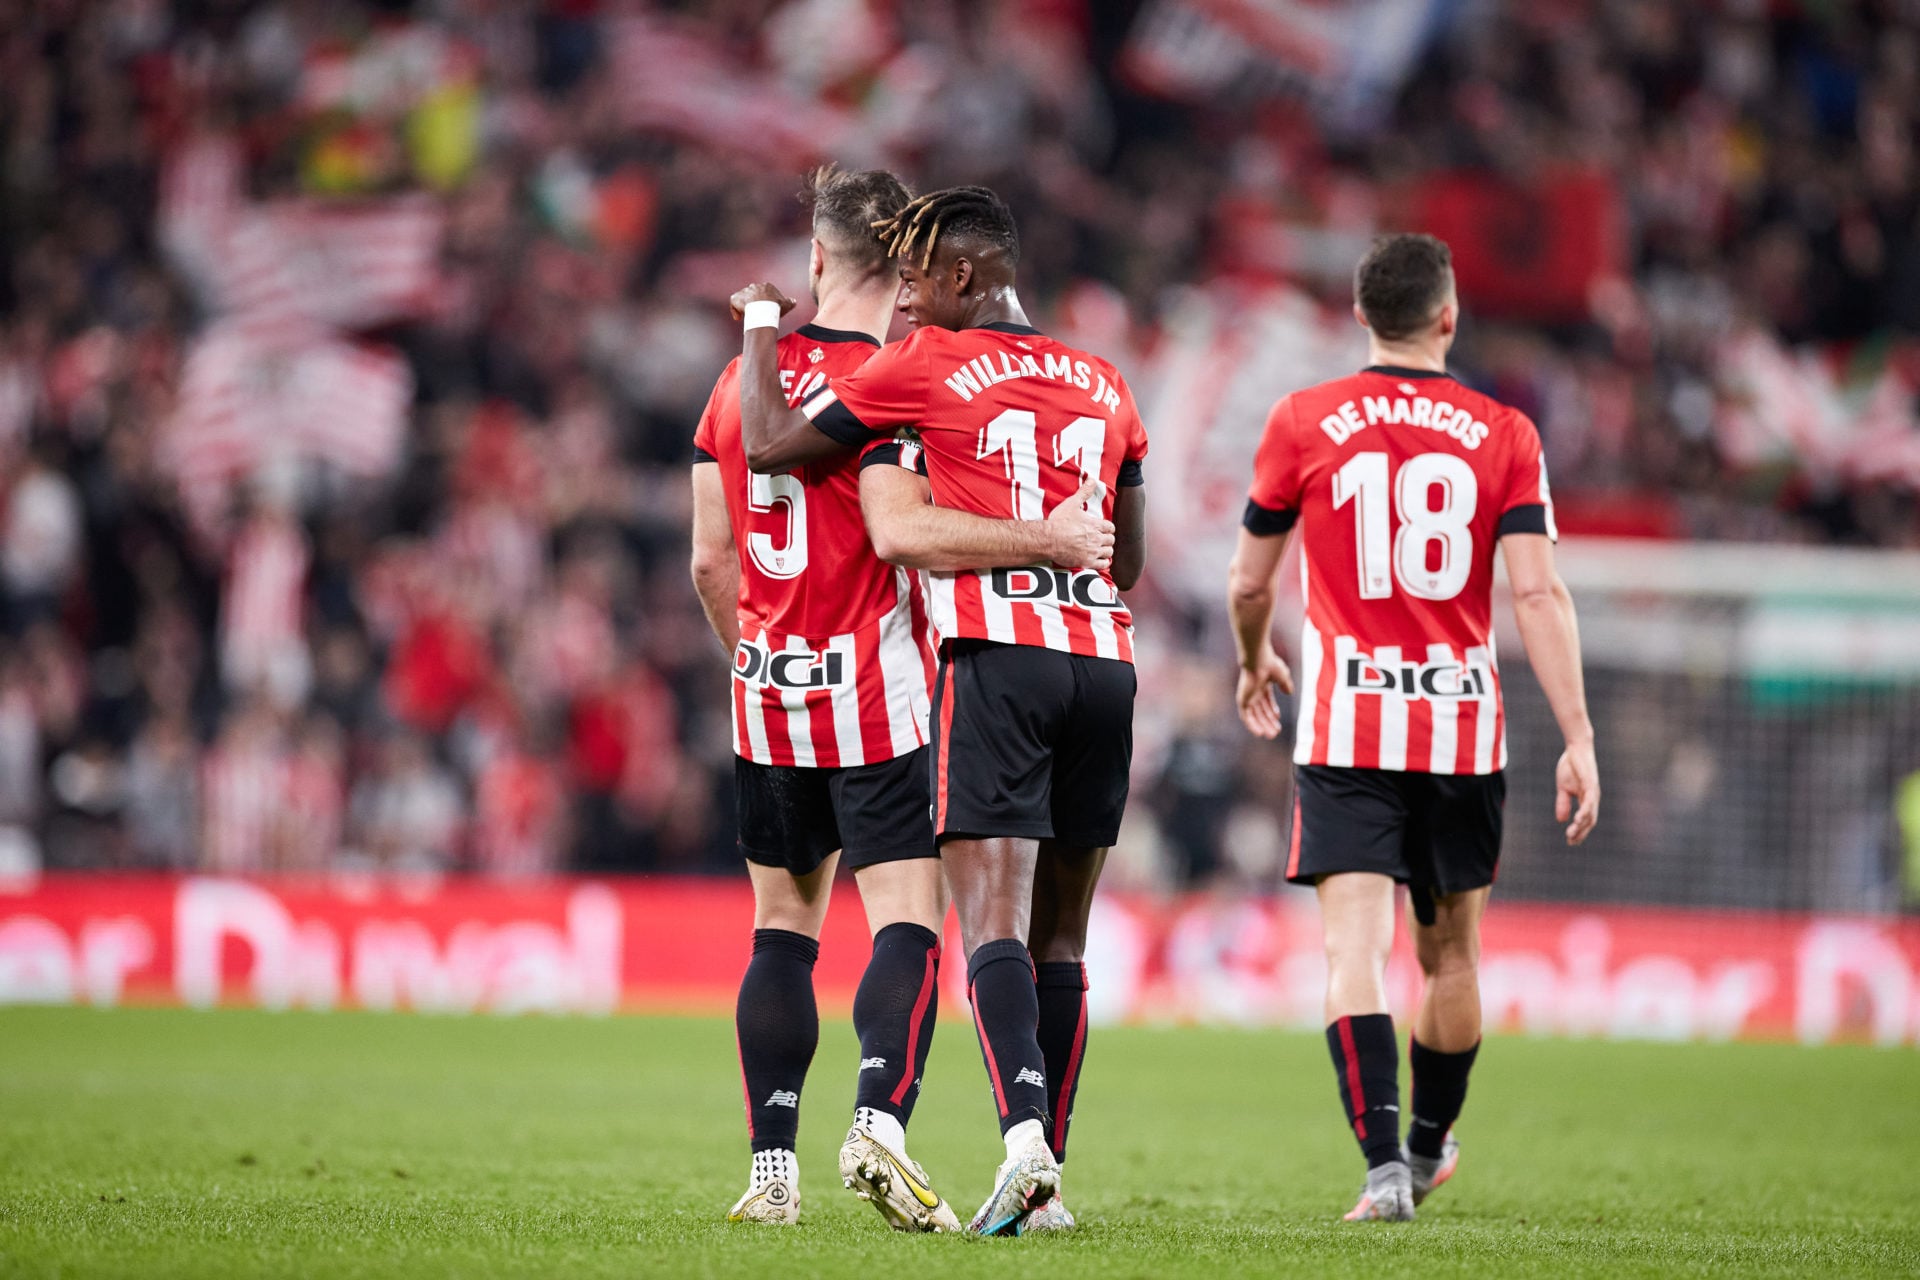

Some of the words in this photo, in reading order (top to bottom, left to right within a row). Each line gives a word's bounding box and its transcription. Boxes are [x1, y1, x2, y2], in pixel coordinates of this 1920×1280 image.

[944, 349, 1091, 402] WILLIAMS
[1091, 373, 1120, 415] JR
[1319, 400, 1367, 446] DE
[1362, 396, 1489, 450] MARCOS
[976, 408, 1107, 521] 11
[747, 468, 808, 580] 5
[1332, 452, 1478, 600] 18
[992, 566, 1125, 608] DIG
[733, 642, 843, 687] DIGI
[1347, 658, 1486, 695] DIGI
